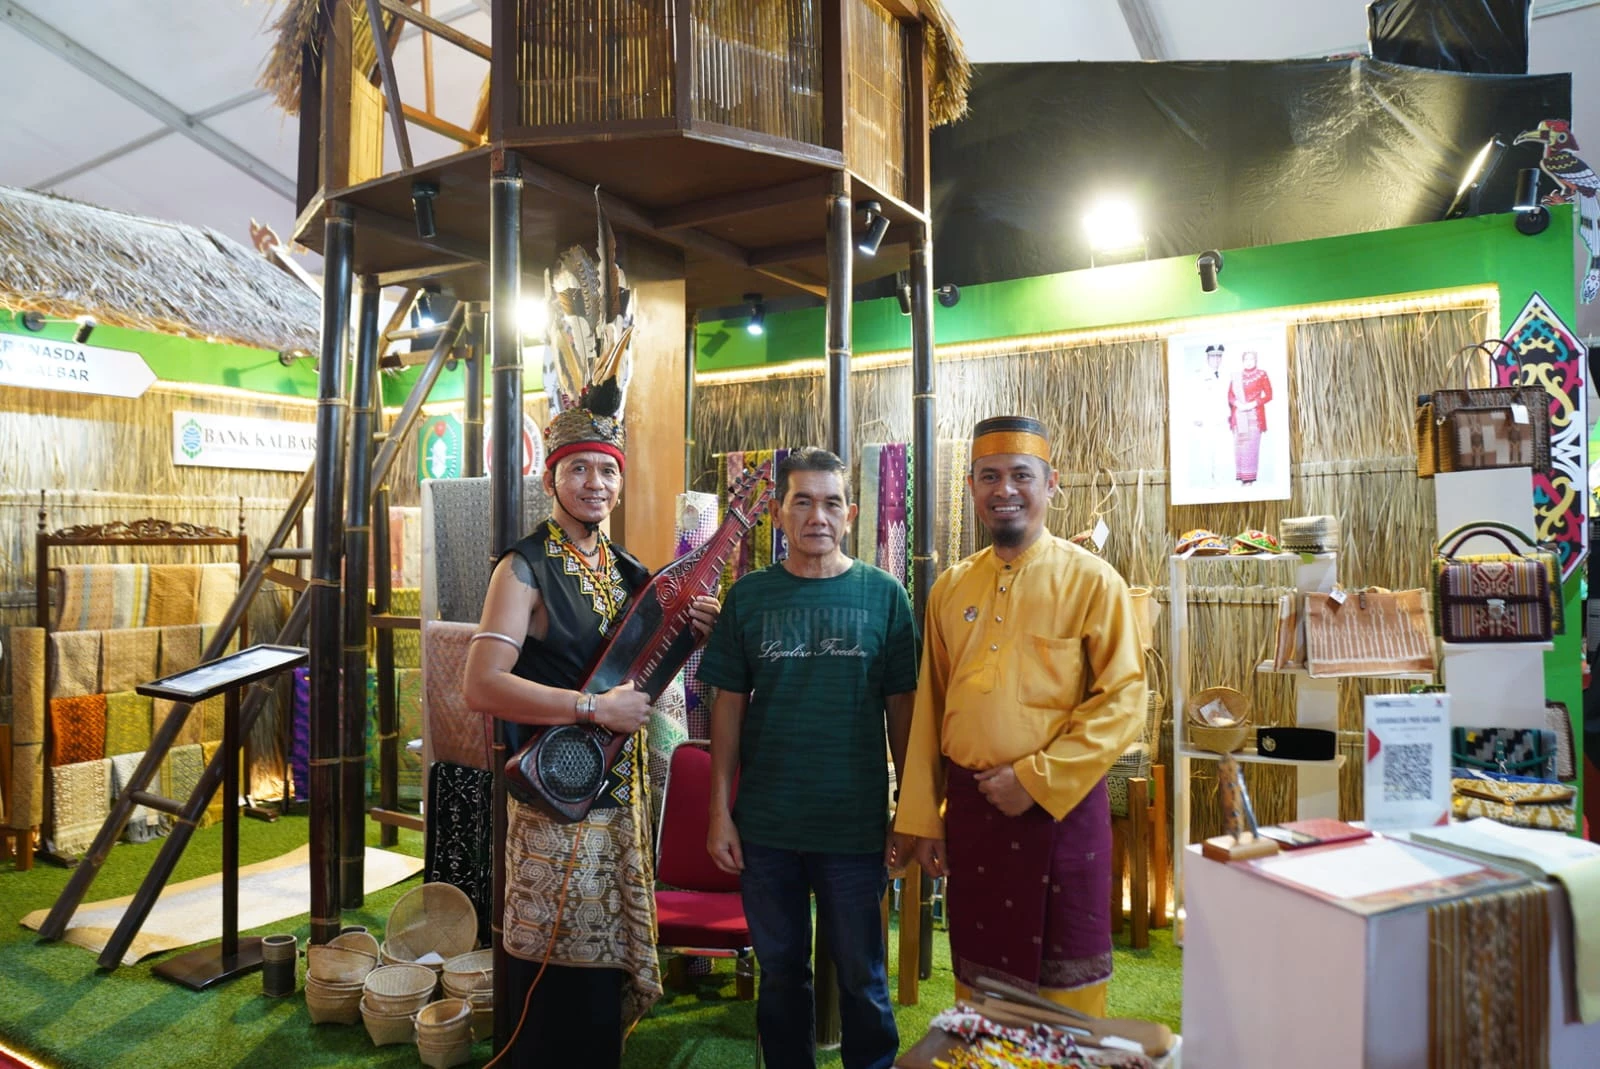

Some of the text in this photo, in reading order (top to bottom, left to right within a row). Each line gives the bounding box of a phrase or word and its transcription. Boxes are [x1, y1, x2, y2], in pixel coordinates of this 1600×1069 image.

[204, 428, 316, 451] BANK KALBAR
[762, 607, 869, 650] INSIGHT
